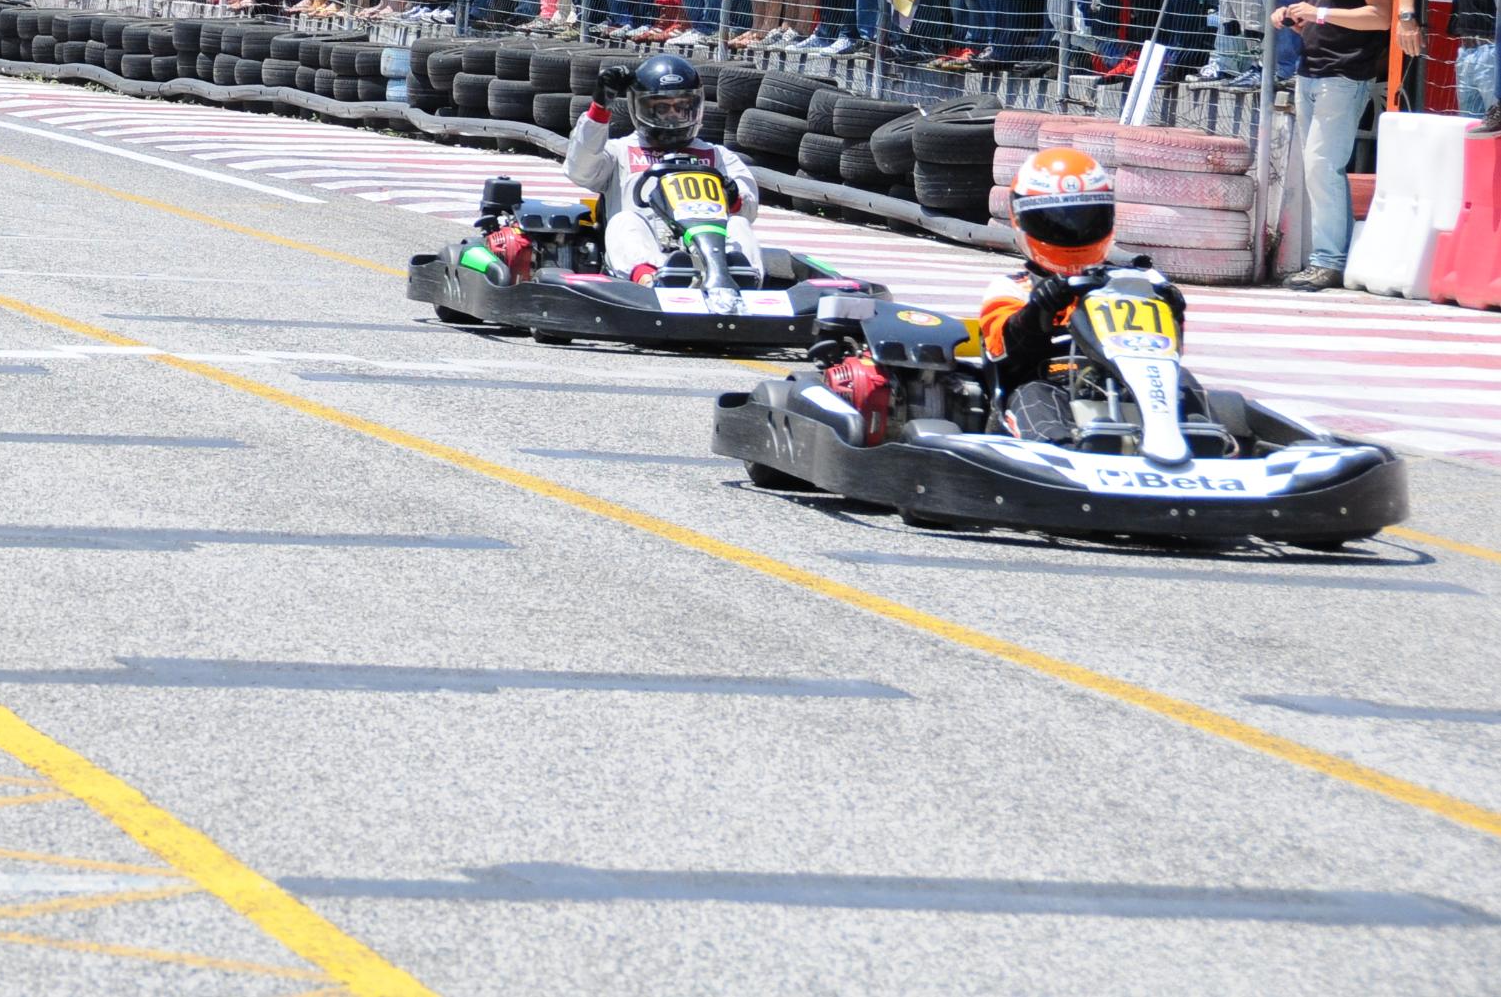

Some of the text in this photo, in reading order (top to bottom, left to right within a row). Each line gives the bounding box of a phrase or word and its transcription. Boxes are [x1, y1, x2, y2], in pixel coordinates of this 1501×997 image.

[668, 176, 720, 202] 100
[1094, 299, 1164, 334] 127
[1146, 365, 1167, 400] Beta
[1134, 471, 1247, 492] Beta
